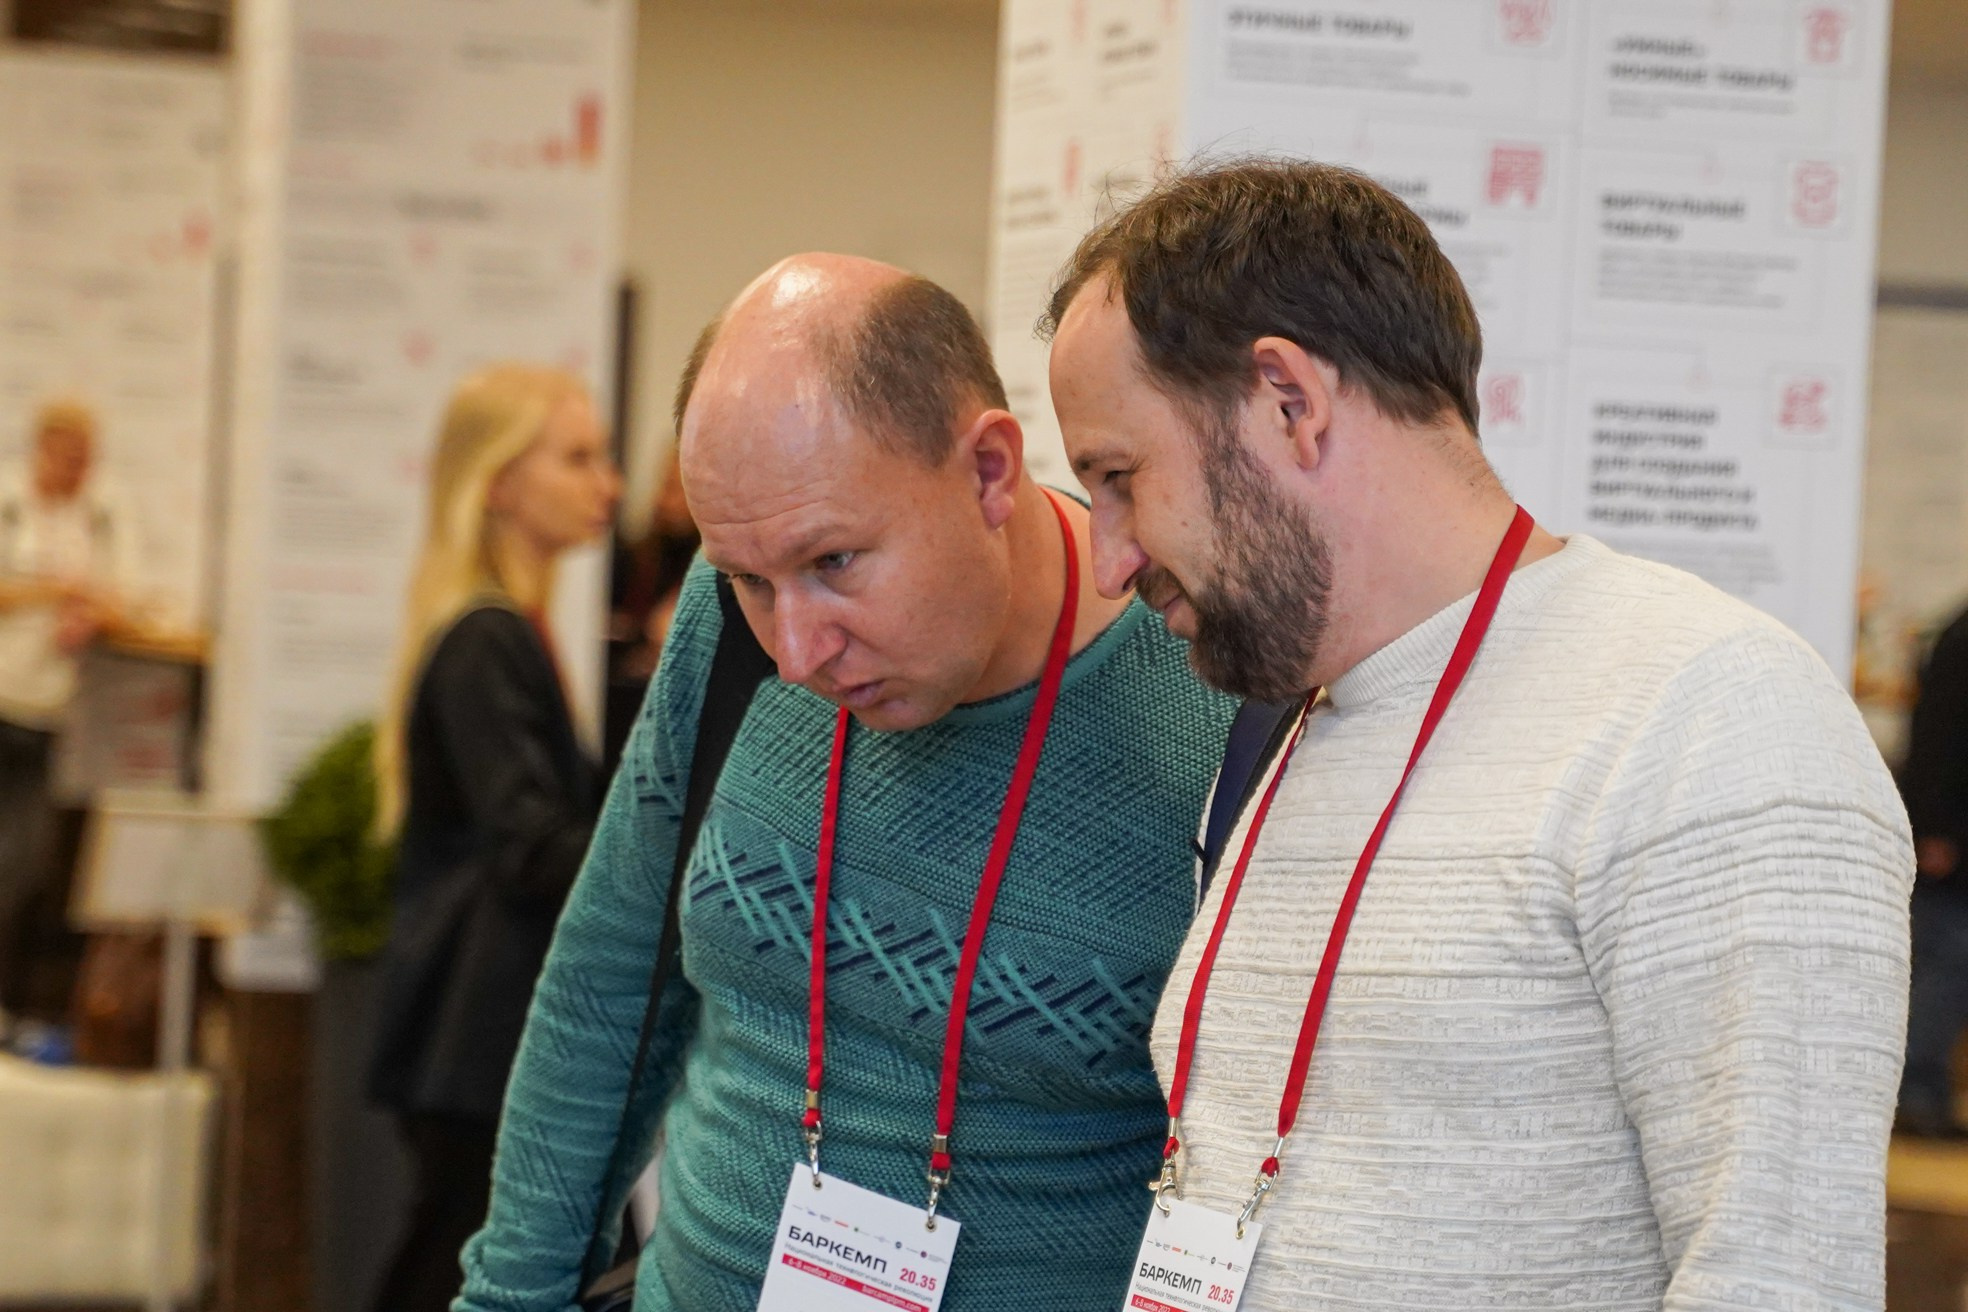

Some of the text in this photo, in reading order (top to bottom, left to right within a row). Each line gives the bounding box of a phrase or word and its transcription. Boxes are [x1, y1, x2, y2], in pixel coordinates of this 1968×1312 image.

[789, 1225, 887, 1273] БАРКЕМП
[899, 1268, 937, 1291] 20.35
[1139, 1262, 1202, 1295] БАРКЕМП
[1207, 1284, 1235, 1305] 20.35
